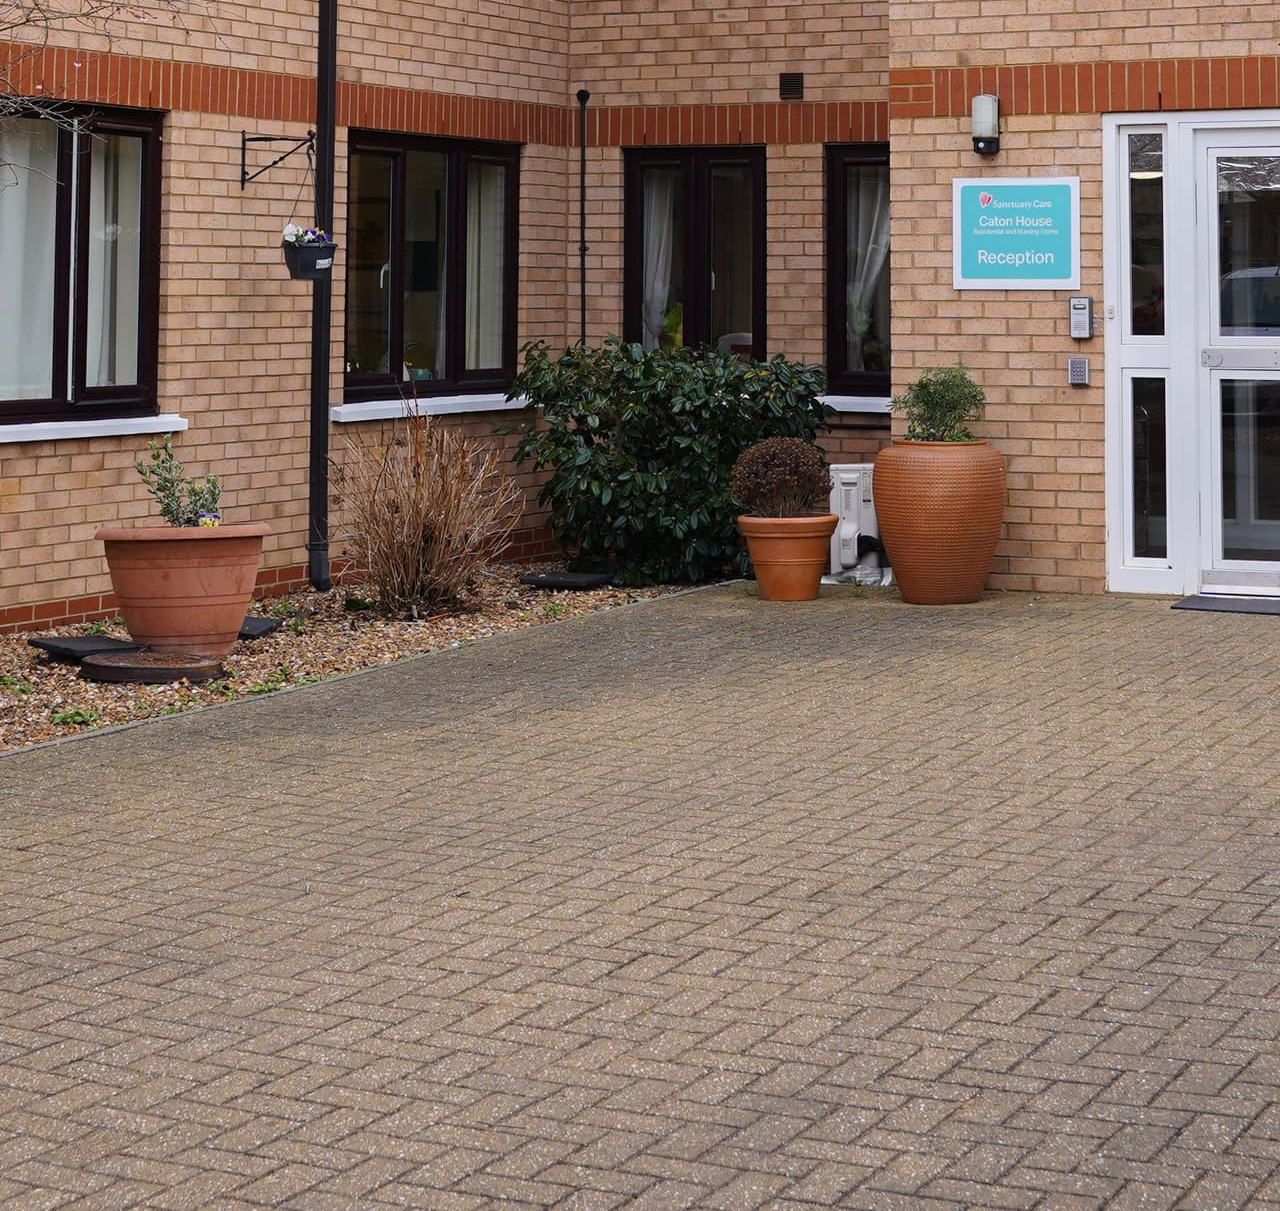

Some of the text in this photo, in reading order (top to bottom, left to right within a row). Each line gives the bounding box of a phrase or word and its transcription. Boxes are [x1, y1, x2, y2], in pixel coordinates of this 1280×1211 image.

[993, 199, 1053, 210] Sanctuary Care
[979, 215, 1053, 227] Caton House
[977, 249, 1055, 267] Reception
